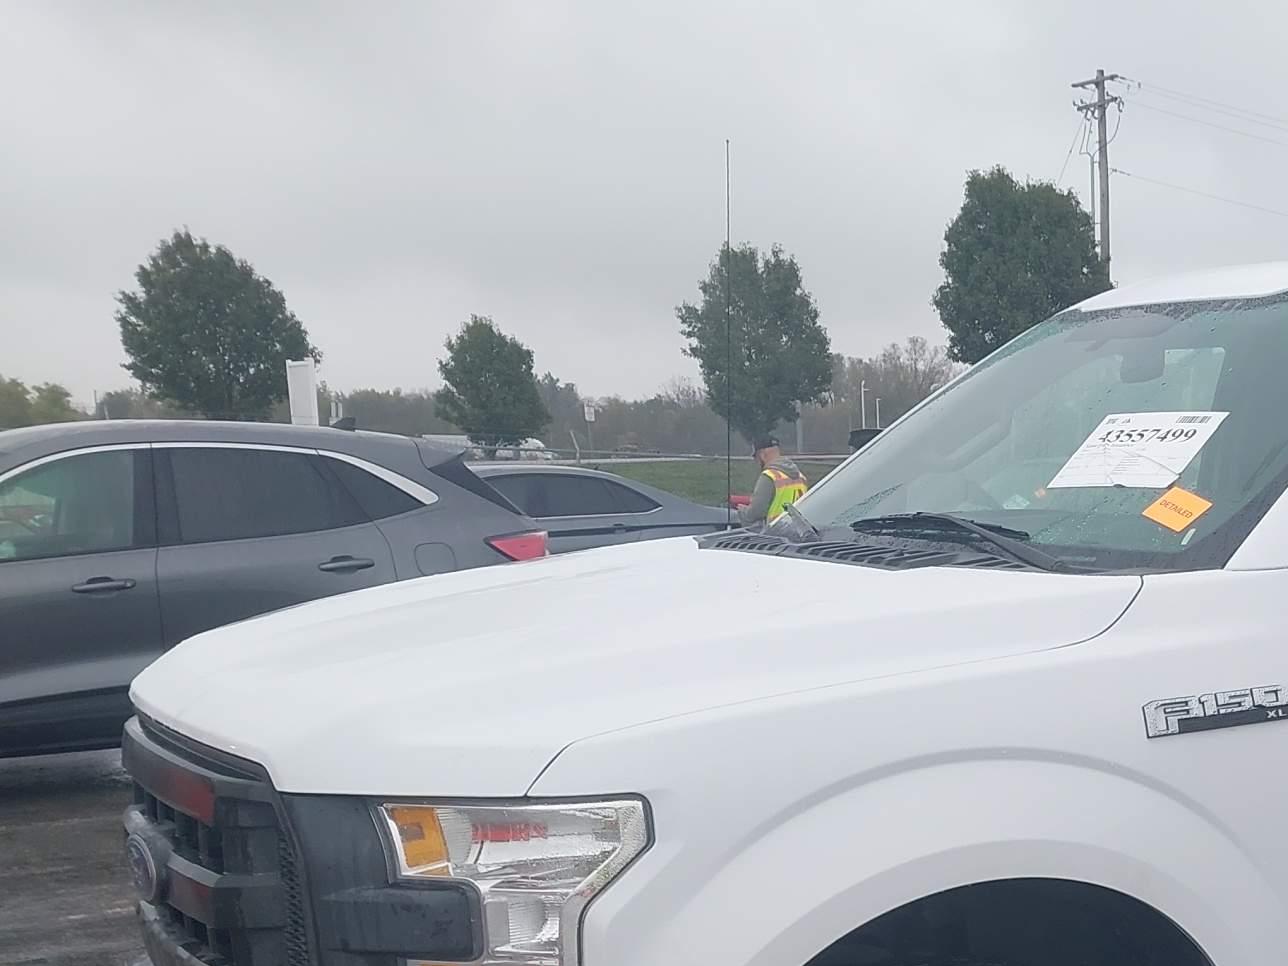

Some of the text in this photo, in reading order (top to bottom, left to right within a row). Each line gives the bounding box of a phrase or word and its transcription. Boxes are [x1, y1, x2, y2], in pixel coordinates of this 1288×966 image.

[1098, 428, 1198, 443] 43557499
[1159, 498, 1193, 519] DETAILED
[1266, 709, 1288, 719] XL
